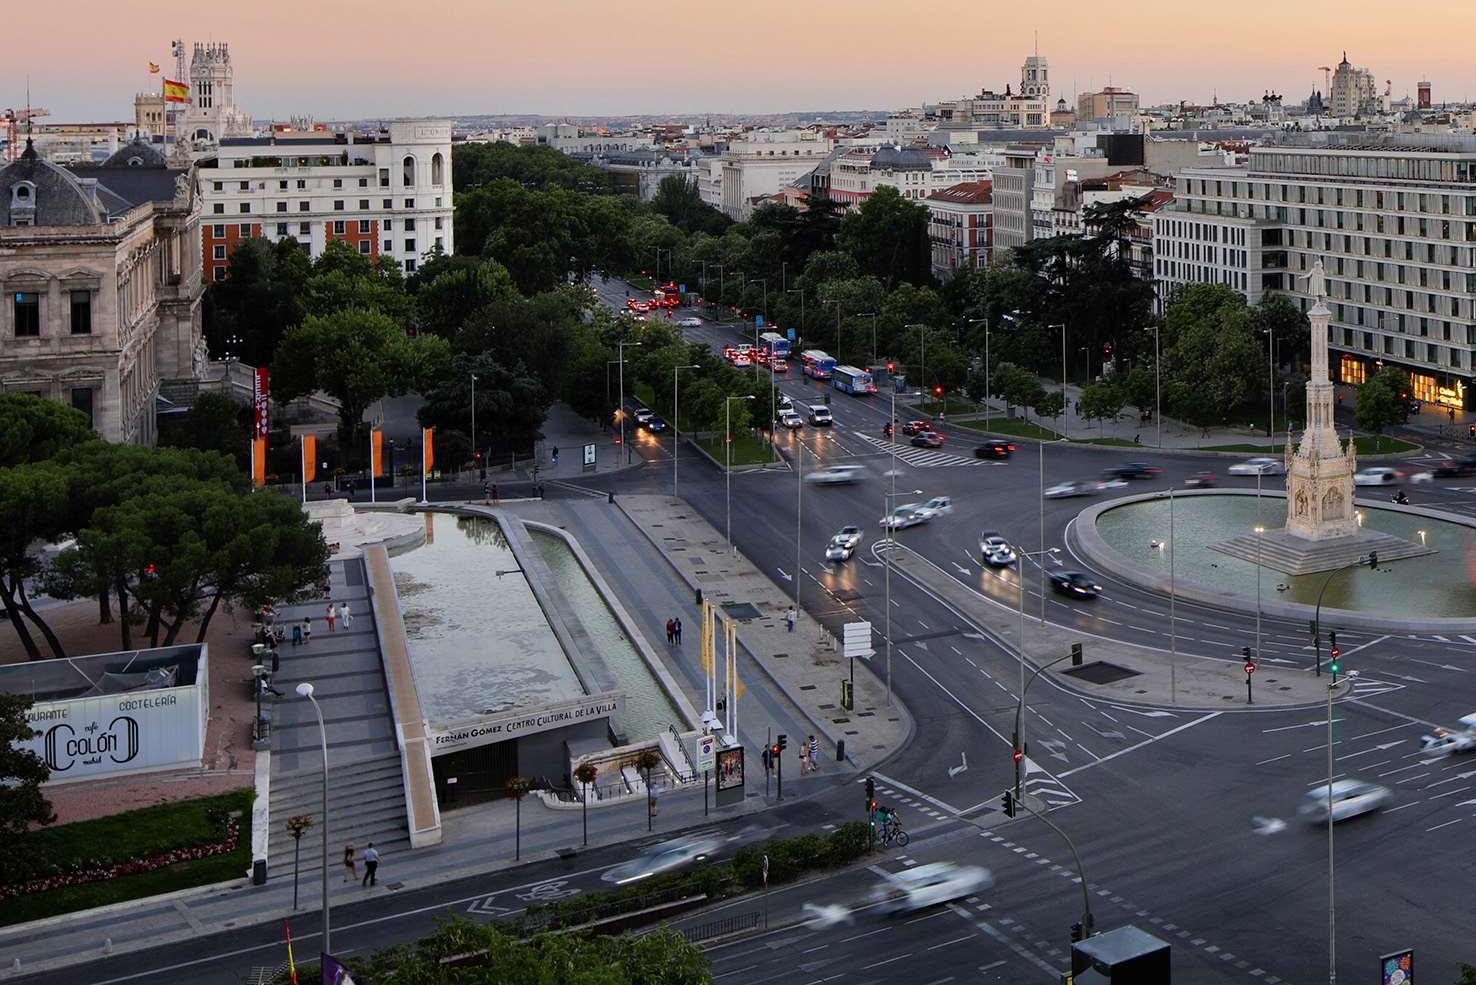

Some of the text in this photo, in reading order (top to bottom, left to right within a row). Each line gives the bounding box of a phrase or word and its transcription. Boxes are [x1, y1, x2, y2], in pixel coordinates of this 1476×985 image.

[119, 695, 177, 712] COCTELERÍA
[24, 708, 69, 723] AURANTE
[506, 718, 536, 733] CENTRO
[537, 711, 573, 727] CULTURAL
[575, 708, 585, 718] DE
[586, 706, 595, 716] LA
[596, 703, 617, 716] VILLA
[67, 732, 117, 757] COLÓN
